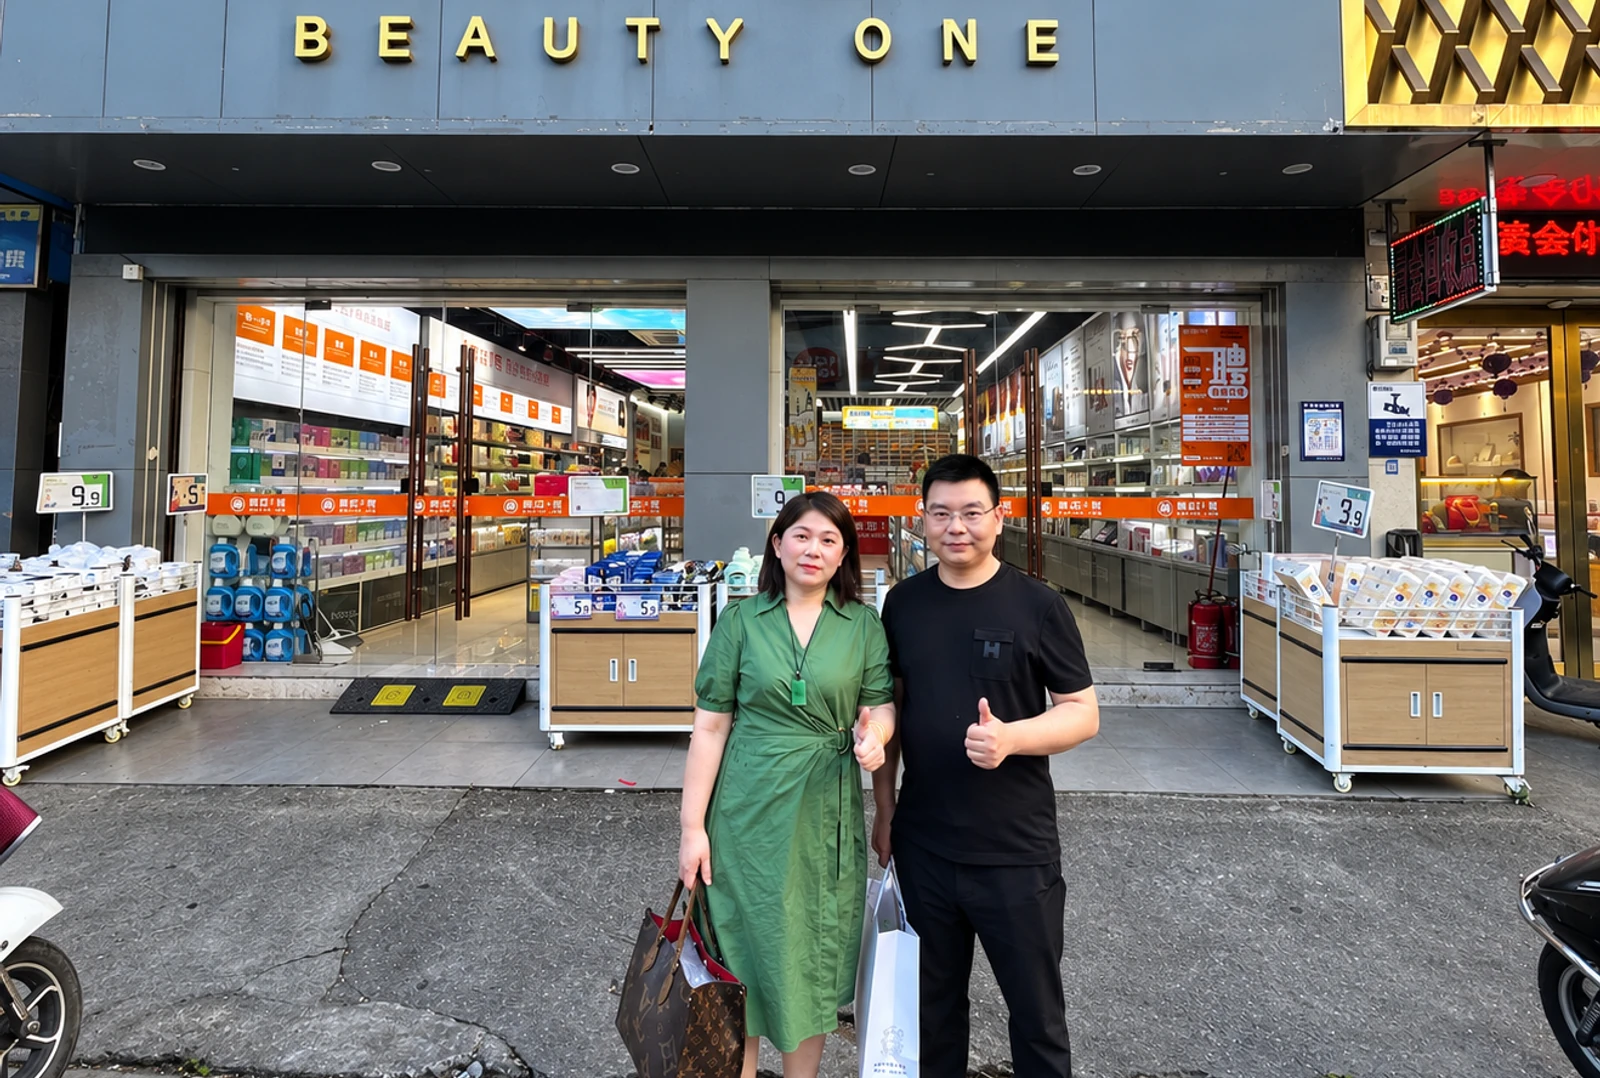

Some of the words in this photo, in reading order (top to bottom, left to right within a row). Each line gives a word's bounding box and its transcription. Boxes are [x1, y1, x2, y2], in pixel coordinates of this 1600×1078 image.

[292, 15, 744, 64] BEAUTY
[854, 18, 1060, 67] ONE
[71, 485, 100, 506] 9.9
[1338, 498, 1363, 527] 3.9
[983, 640, 1001, 659] H
